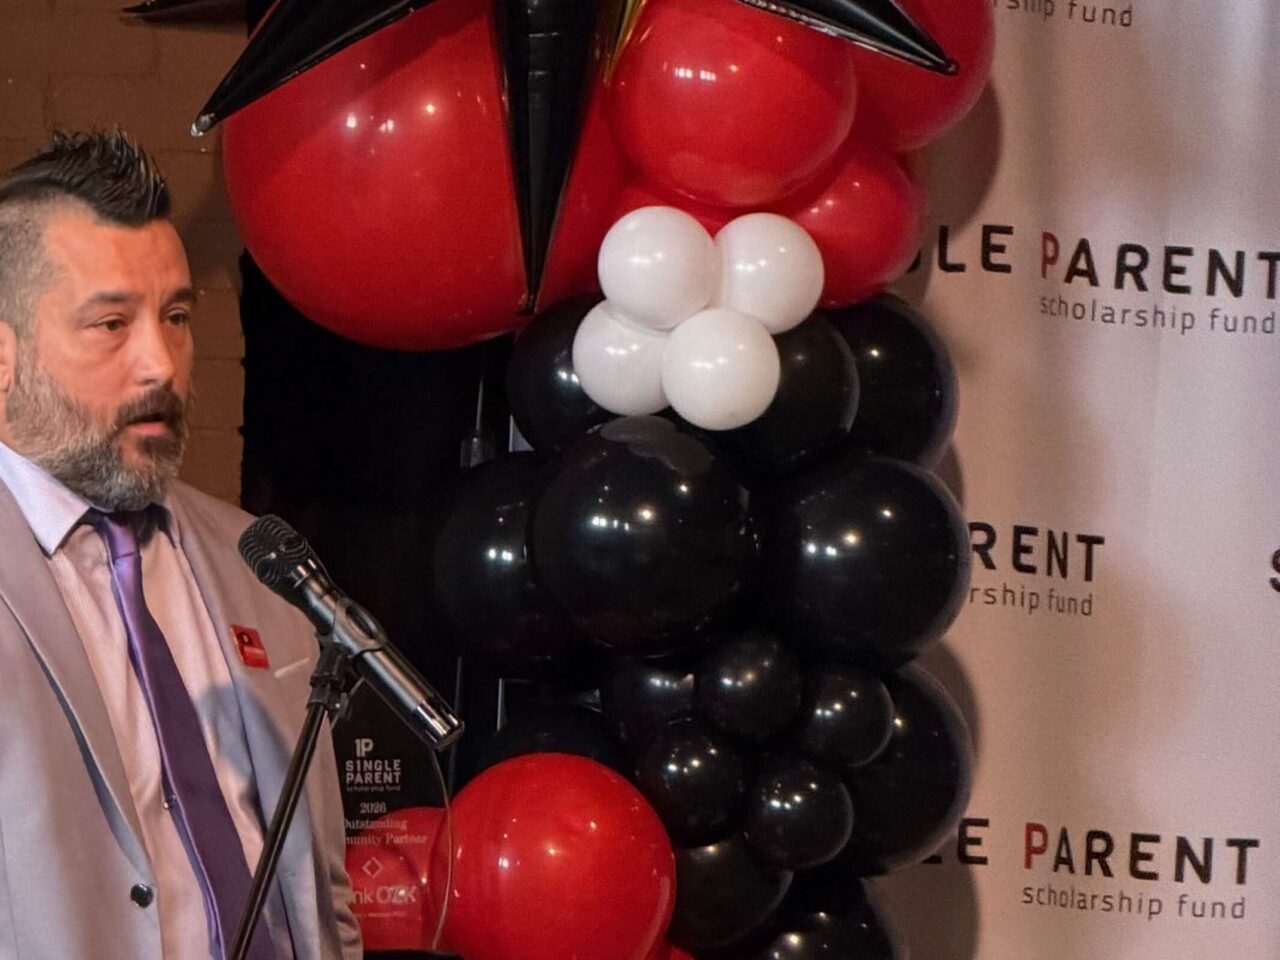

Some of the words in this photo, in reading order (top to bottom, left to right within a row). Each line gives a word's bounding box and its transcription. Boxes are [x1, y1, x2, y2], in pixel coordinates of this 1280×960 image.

[907, 223, 1015, 273] LE
[1040, 296, 1195, 335] scholarship
[1210, 308, 1277, 334] fund
[968, 521, 1105, 582] RENT
[969, 583, 1040, 614] rship
[1048, 588, 1093, 617] fund
[346, 772, 401, 784] PARENT
[1024, 822, 1260, 885] PARENT
[1022, 886, 1163, 920] scholarship
[1177, 894, 1246, 919] fund
